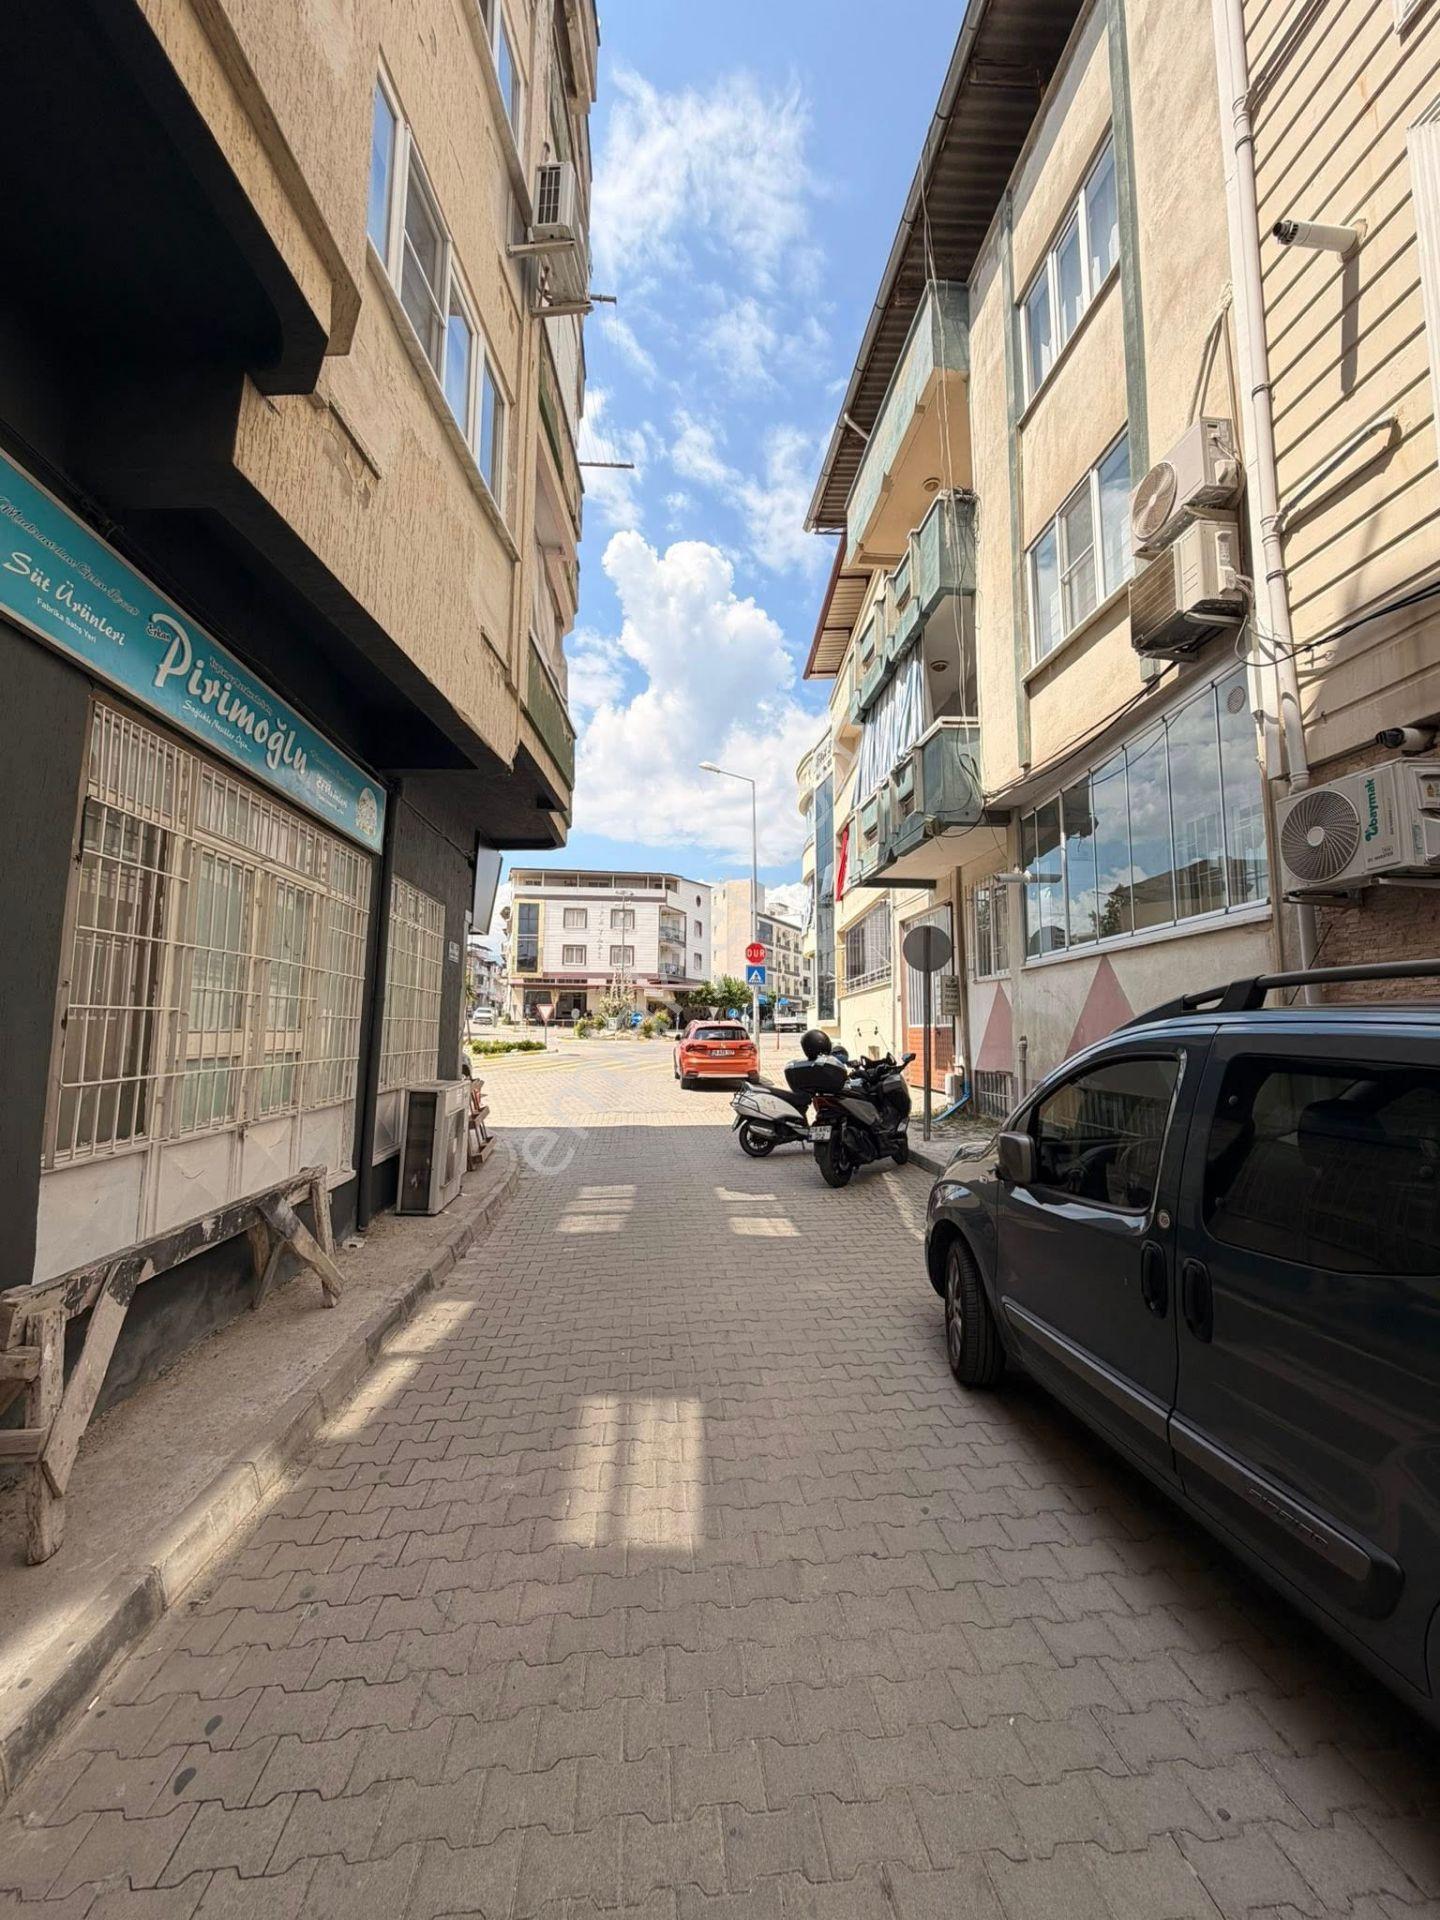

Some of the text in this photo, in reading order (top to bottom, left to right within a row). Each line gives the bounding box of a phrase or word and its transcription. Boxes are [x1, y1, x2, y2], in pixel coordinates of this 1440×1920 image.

[3, 551, 126, 646] Süt Ürünleri
[36, 597, 64, 622] Fabrika
[65, 617, 83, 635] Satış
[151, 613, 308, 774] Pirimoğlu
[1365, 778, 1379, 830] baymak
[747, 948, 765, 958] DUR
